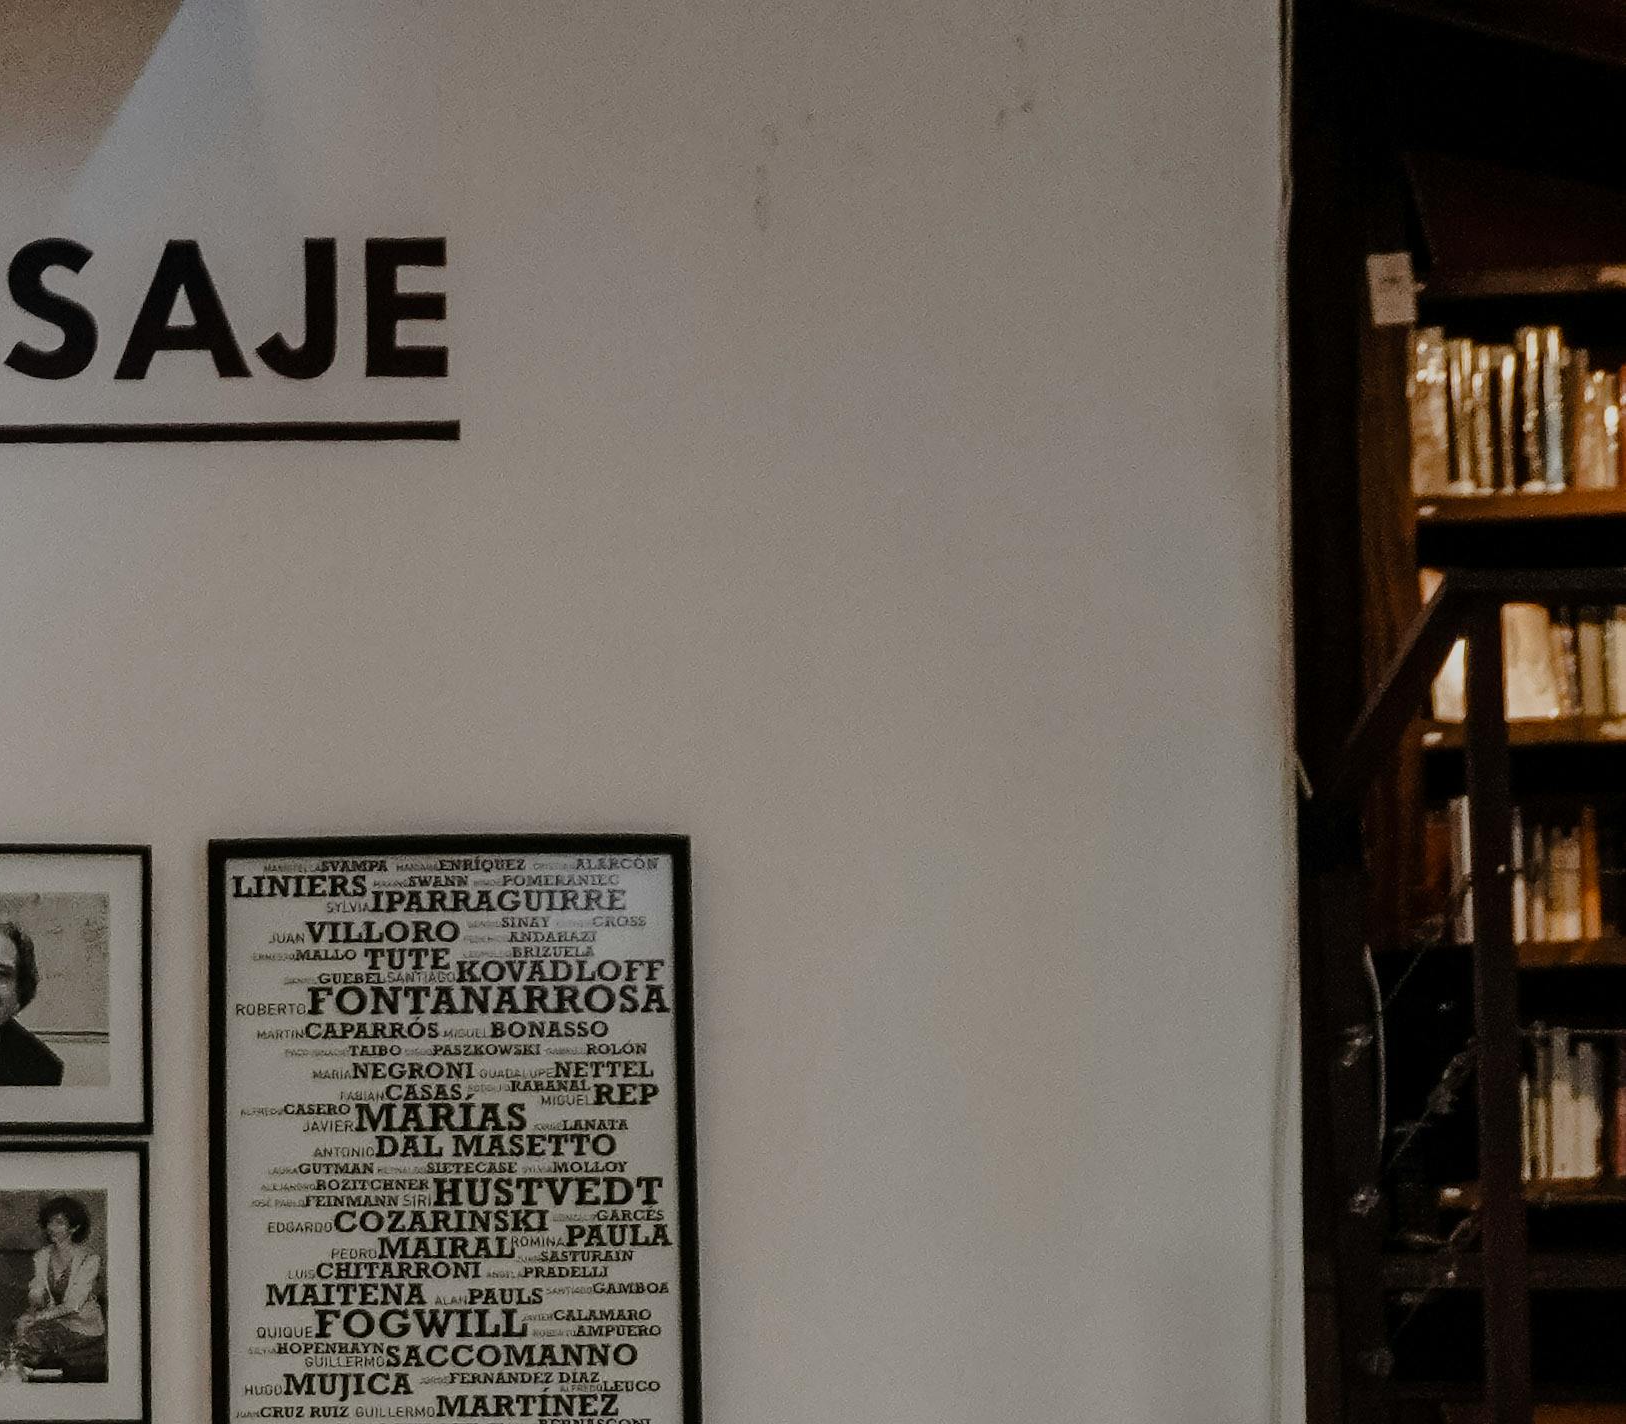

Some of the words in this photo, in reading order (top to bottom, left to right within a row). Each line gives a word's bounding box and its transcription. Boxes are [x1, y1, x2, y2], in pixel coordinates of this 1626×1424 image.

[232, 875, 367, 898] LINIERS
[371, 889, 626, 912] IPARRAGUIRRE
[269, 933, 305, 944] JUAN
[305, 920, 460, 943] VILLORO
[295, 949, 357, 961] MALLO
[364, 948, 451, 970] TUTE
[456, 959, 665, 983] KOVADLOFF
[236, 1003, 307, 1016] ROBERTO
[307, 984, 671, 1015] FONTANARROSA
[305, 1017, 439, 1040] CAPARRÓS
[490, 1021, 609, 1038] BONASSO
[349, 1045, 402, 1057] TAIBO
[352, 1061, 475, 1080] NEGRONI
[554, 1060, 654, 1078] NETTEL
[385, 1083, 462, 1101] CASAS
[593, 1083, 659, 1106] REP
[284, 1103, 351, 1115] CASERO
[303, 1120, 354, 1133] JAVIER
[354, 1095, 527, 1132] MARÍAS
[562, 1119, 629, 1131] LANATA
[375, 1134, 443, 1158] DAL
[452, 1133, 617, 1157] MASETTO
[298, 1163, 374, 1175] GUTMAN
[552, 1161, 628, 1173] MOLLOY
[432, 1176, 663, 1206] HUSTVEDT
[334, 1209, 549, 1233] COZARINSKI
[565, 1223, 673, 1247] PAULA
[377, 1236, 516, 1259] MAIRAL
[315, 1261, 482, 1280] CHITARRONI
[523, 1265, 609, 1278] PRADELLI
[265, 1283, 428, 1306] MAITENA
[467, 1287, 544, 1305] PAULS
[314, 1308, 528, 1339] FOGWILL
[553, 1308, 652, 1322] CALAMARO
[576, 1324, 662, 1337] AMPUERO
[385, 1343, 638, 1368] SACCOMANNO
[283, 1372, 414, 1402] MUJICA
[260, 1406, 304, 1418] CRUZ
[310, 1406, 349, 1418] RUIZ
[435, 1387, 618, 1418] MARTÍNEZ
